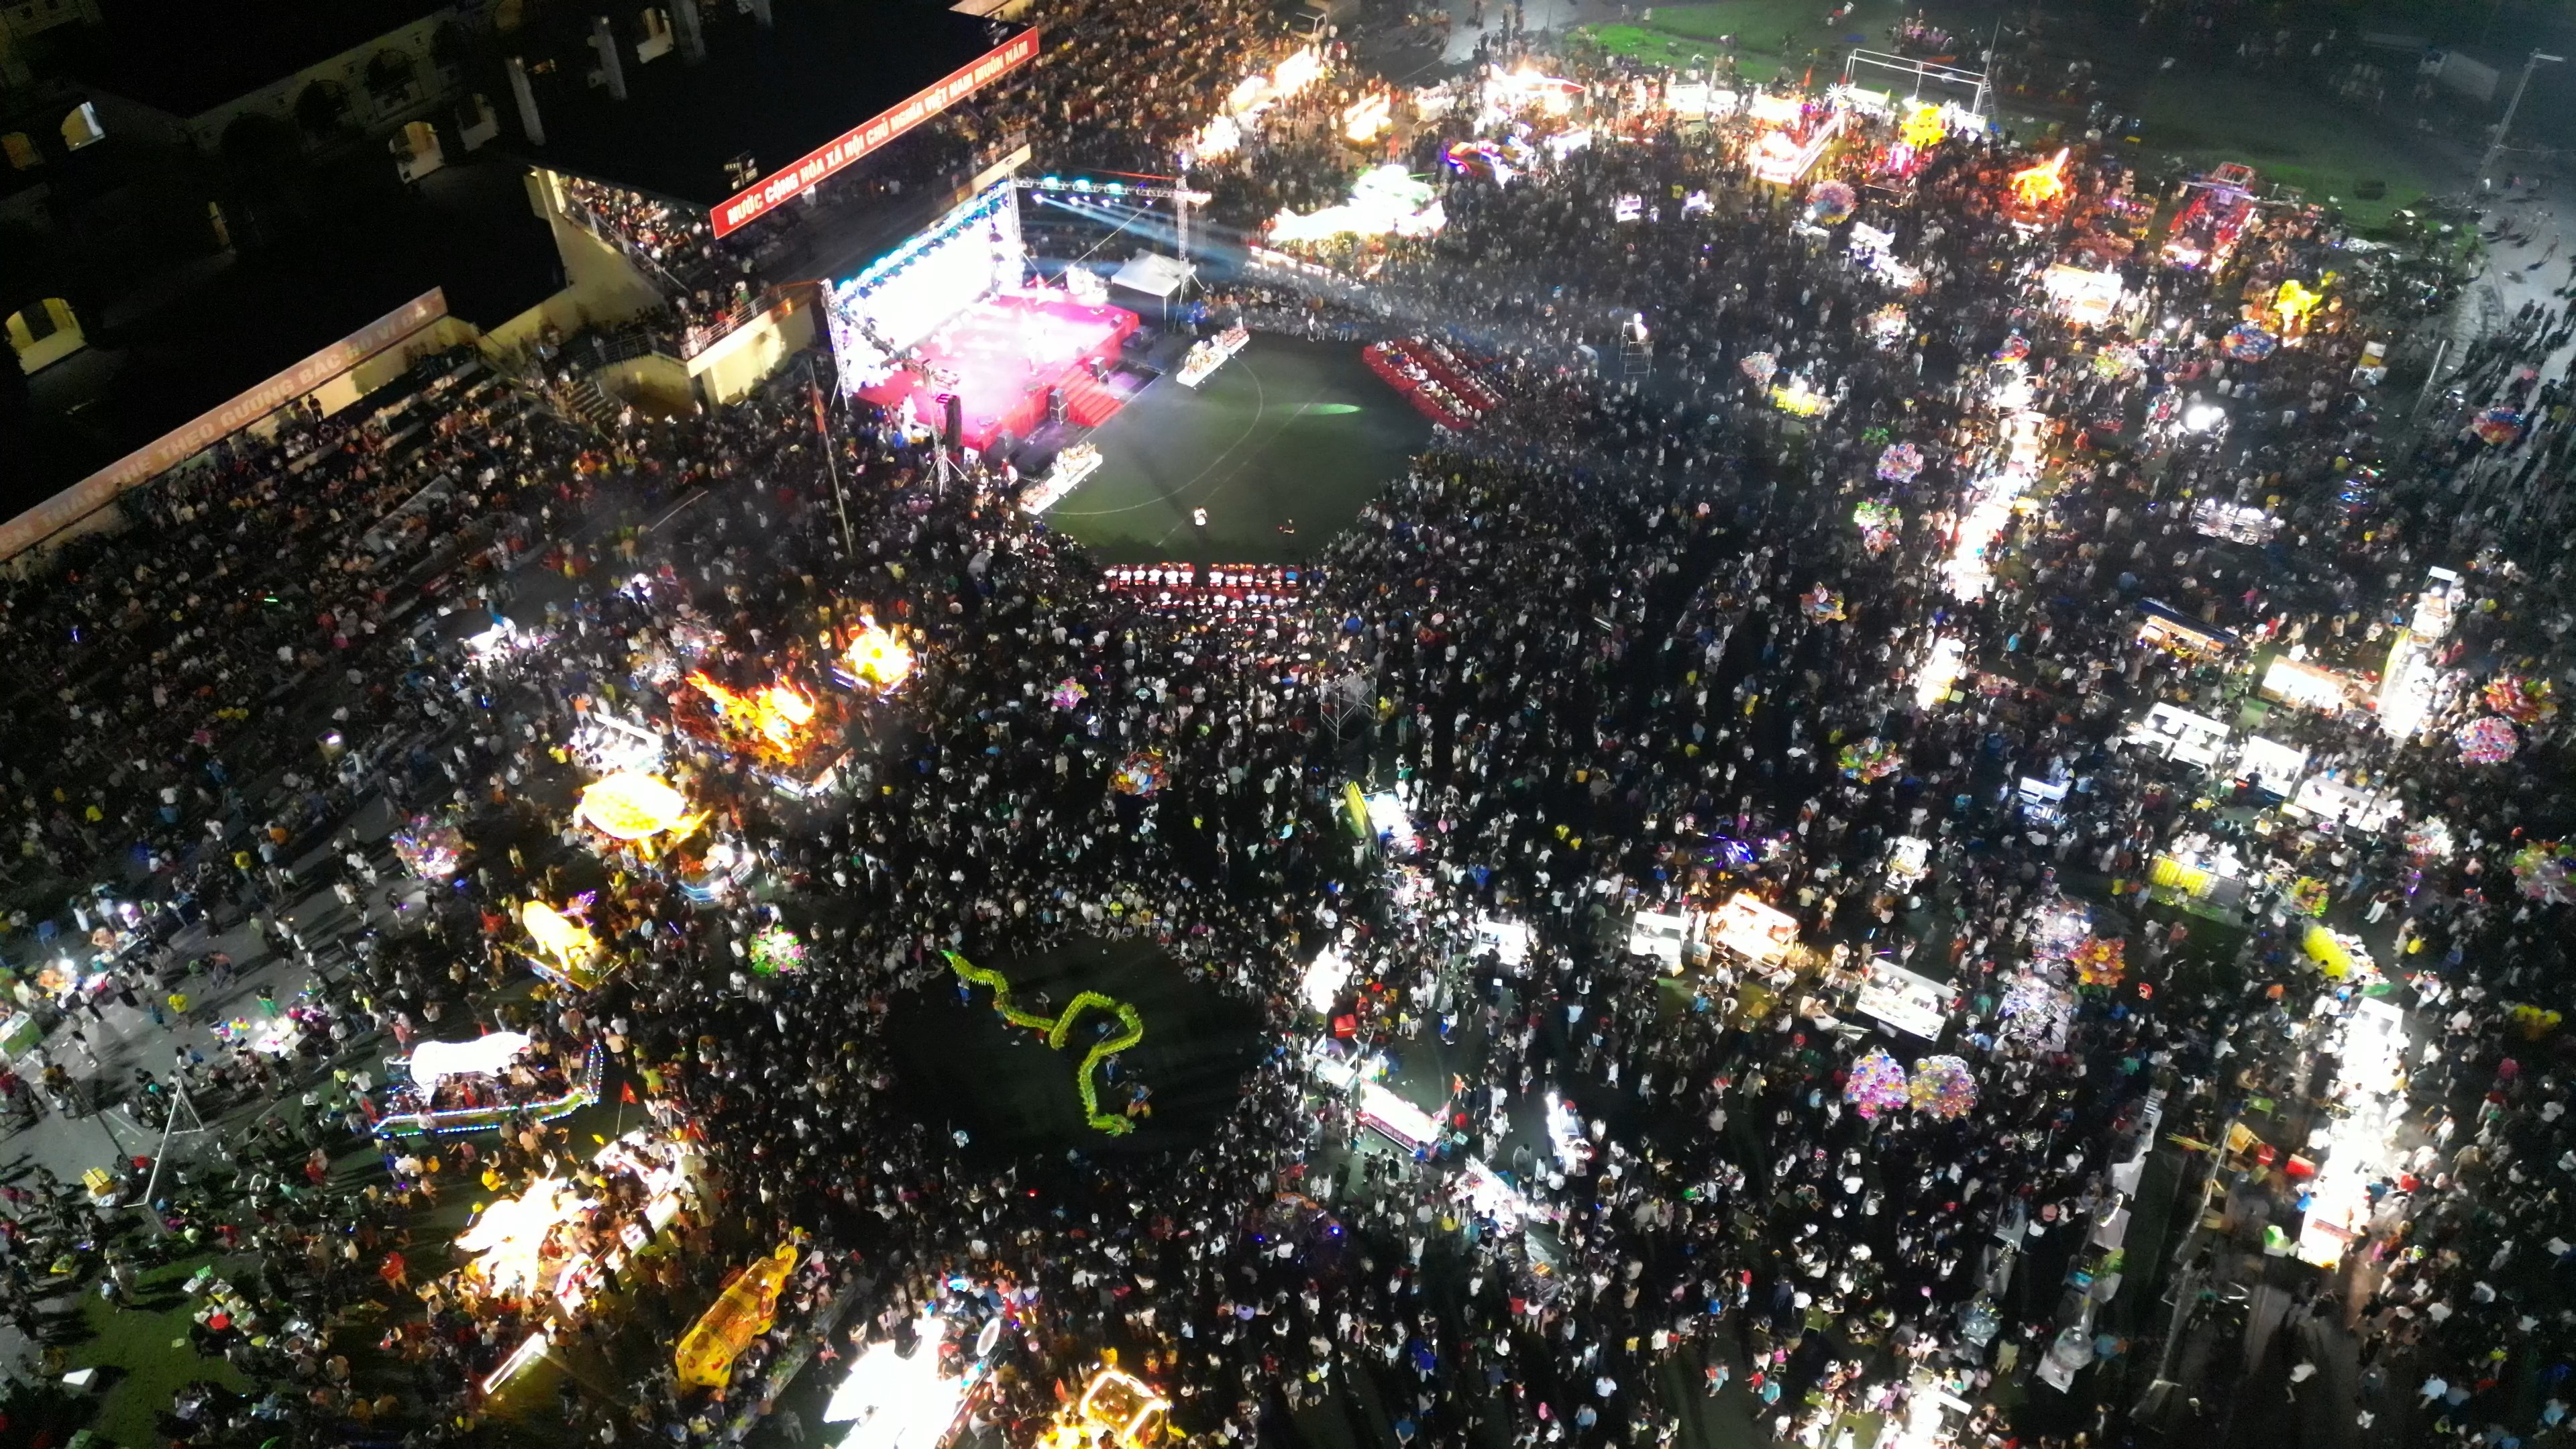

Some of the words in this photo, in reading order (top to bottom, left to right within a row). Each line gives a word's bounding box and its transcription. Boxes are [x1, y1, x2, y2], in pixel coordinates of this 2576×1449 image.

[727, 194, 763, 225] NƯỚC
[765, 172, 799, 203] CỘNG
[800, 158, 825, 184] HÒA
[825, 144, 843, 168] XÃ
[844, 134, 864, 158] HỘI
[866, 117, 889, 145] CHỦ
[890, 101, 924, 131] NGHĨA
[924, 87, 947, 112] VIỆT
[949, 72, 973, 99] NAM
[975, 55, 1004, 83] MUÔN
[1005, 41, 1028, 65] NĂM
[157, 422, 215, 462] THEO
[298, 353, 341, 385] BÁC
